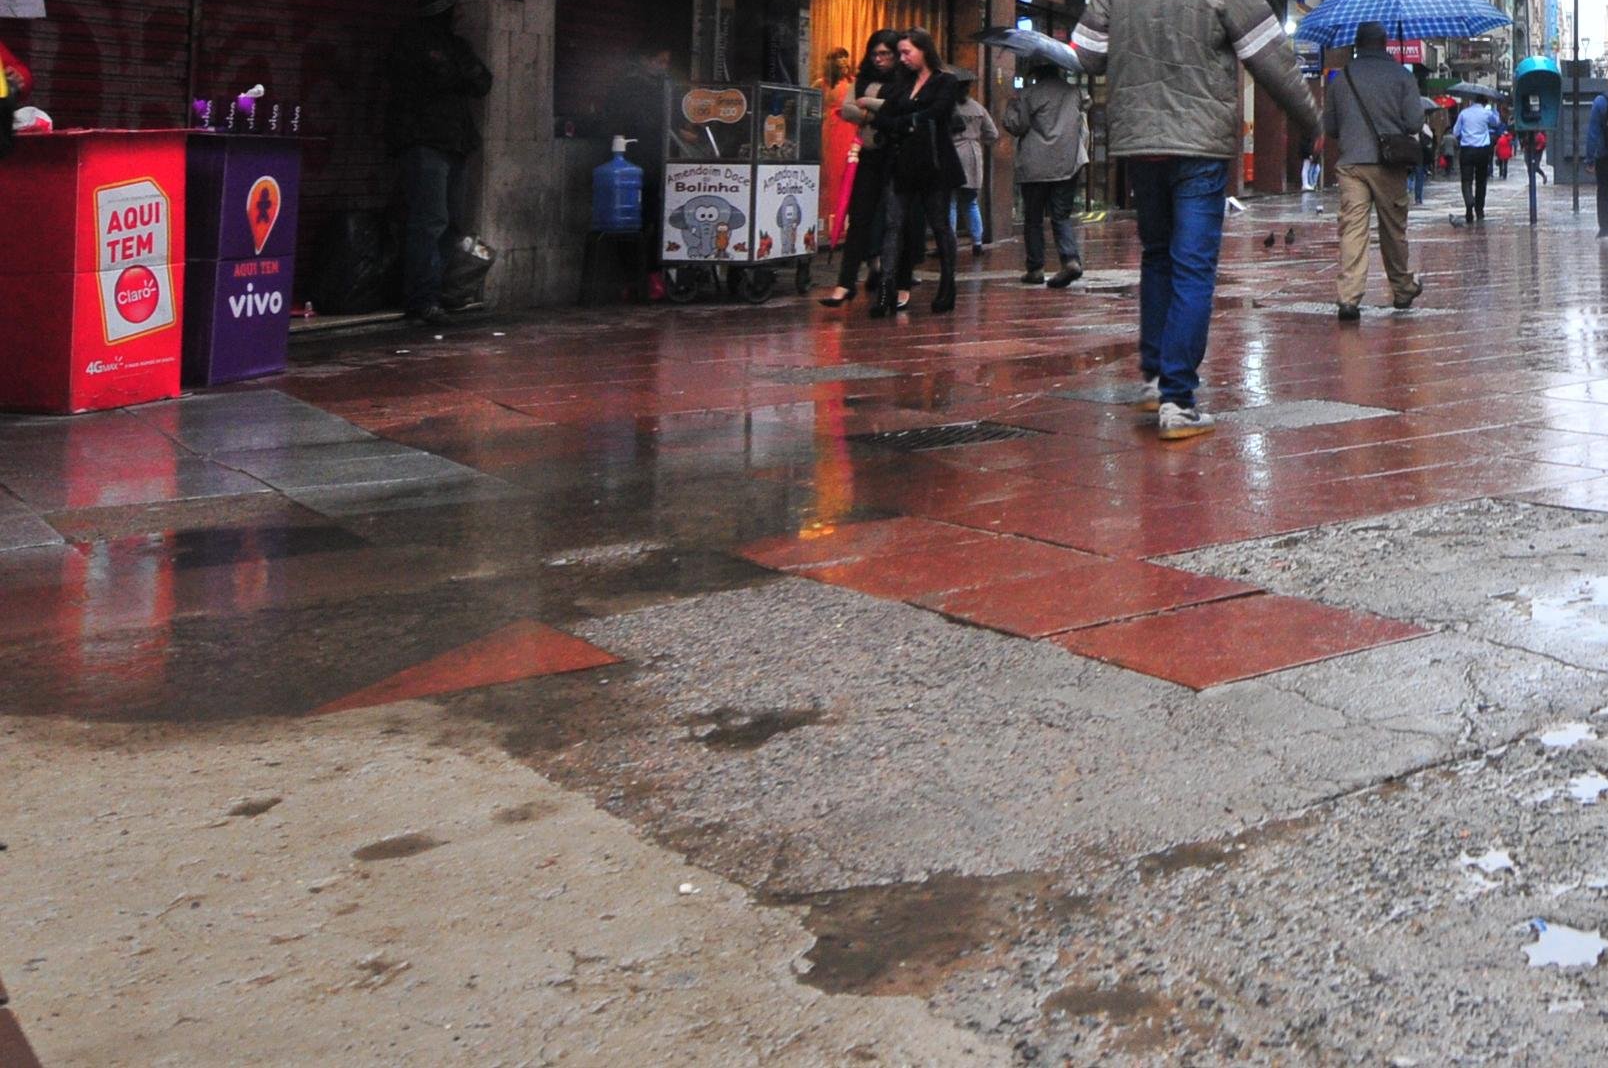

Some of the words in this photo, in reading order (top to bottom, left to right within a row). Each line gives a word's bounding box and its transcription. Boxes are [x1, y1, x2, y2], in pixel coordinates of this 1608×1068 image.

[667, 165, 722, 185] Amendoim
[725, 168, 750, 187] Doce
[675, 181, 740, 193] Bolinha
[107, 201, 162, 235] AQUI
[106, 232, 154, 264] TEM
[233, 262, 257, 278] AQUI
[259, 260, 280, 275] TEM
[117, 281, 154, 306] Claro
[228, 282, 283, 319] vivo
